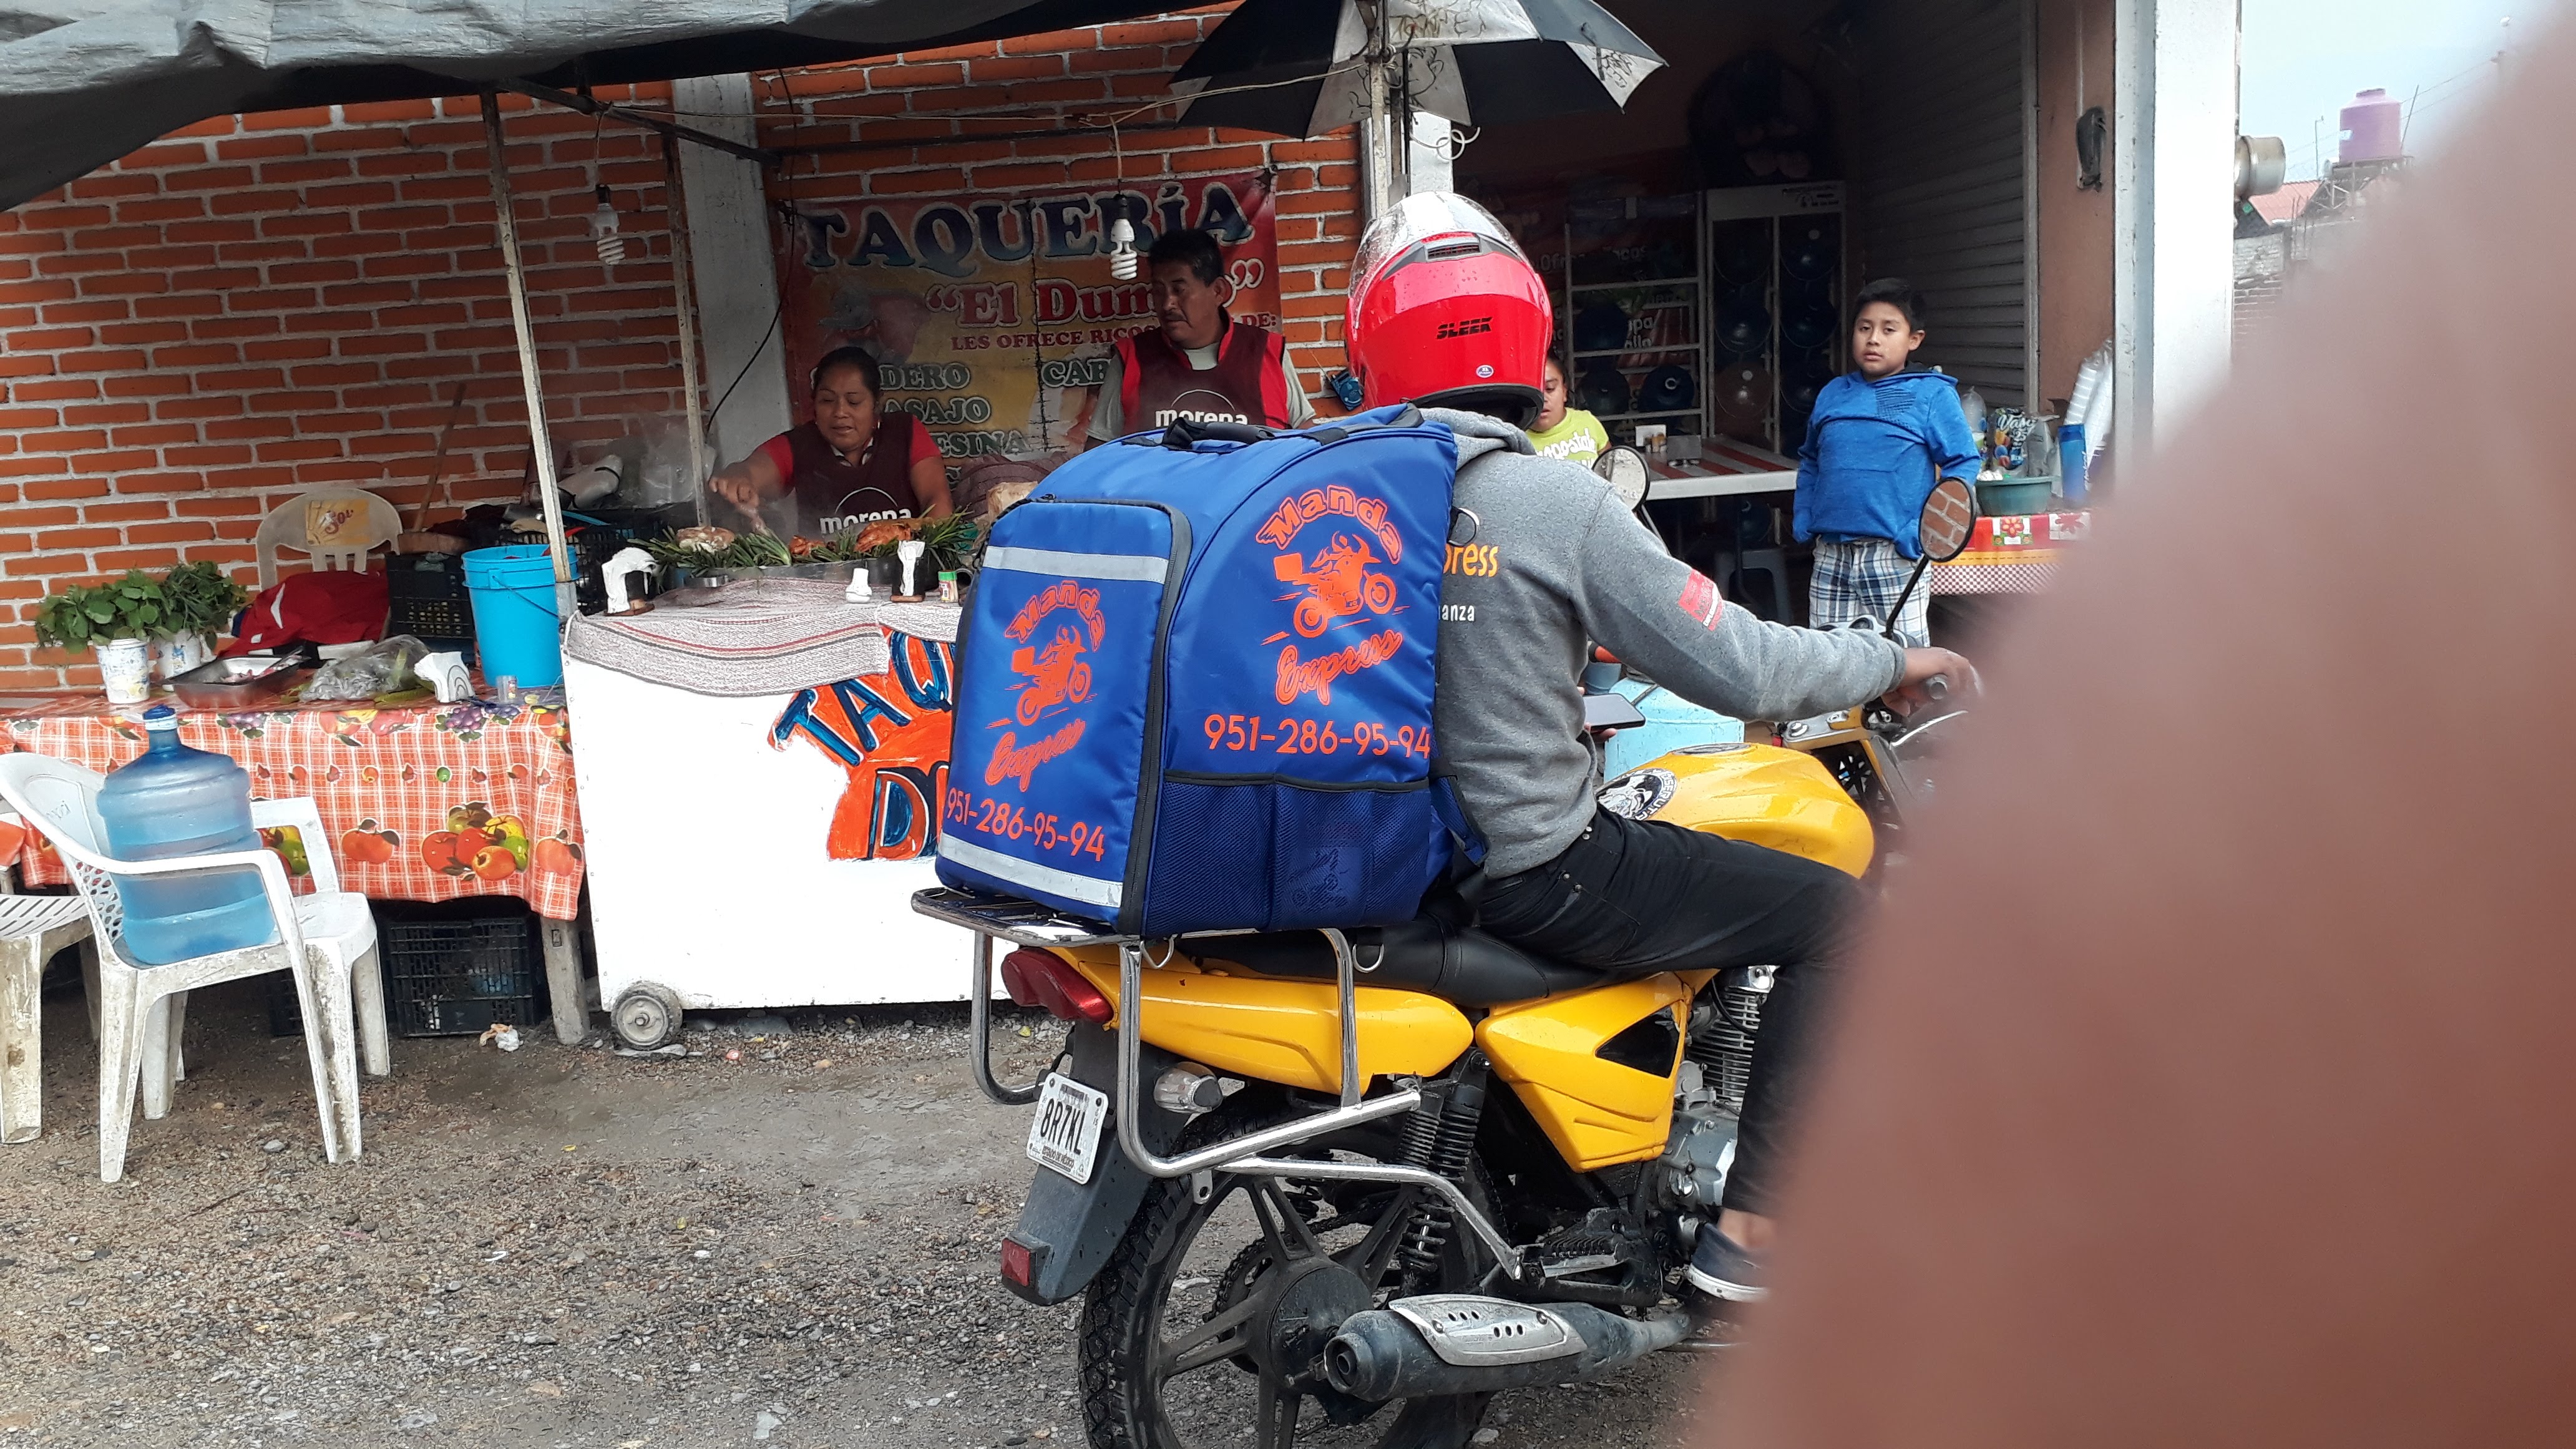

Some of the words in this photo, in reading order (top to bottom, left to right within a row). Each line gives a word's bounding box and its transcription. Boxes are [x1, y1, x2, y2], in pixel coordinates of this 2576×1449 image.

[950, 335, 990, 351] LES
[997, 331, 1083, 349] OFRECE
[1155, 409, 1248, 427] morena
[819, 508, 912, 534] morena
[1256, 484, 1402, 564] Manda
[1005, 579, 1105, 652] Manda
[1438, 604, 1475, 622] anza
[774, 629, 955, 767] TAQ
[1276, 629, 1403, 705] Express
[985, 718, 1086, 793] Express
[1204, 713, 1430, 759] 951-286-95-94
[870, 763, 949, 860] D
[947, 786, 1105, 861] 951-286-95-94
